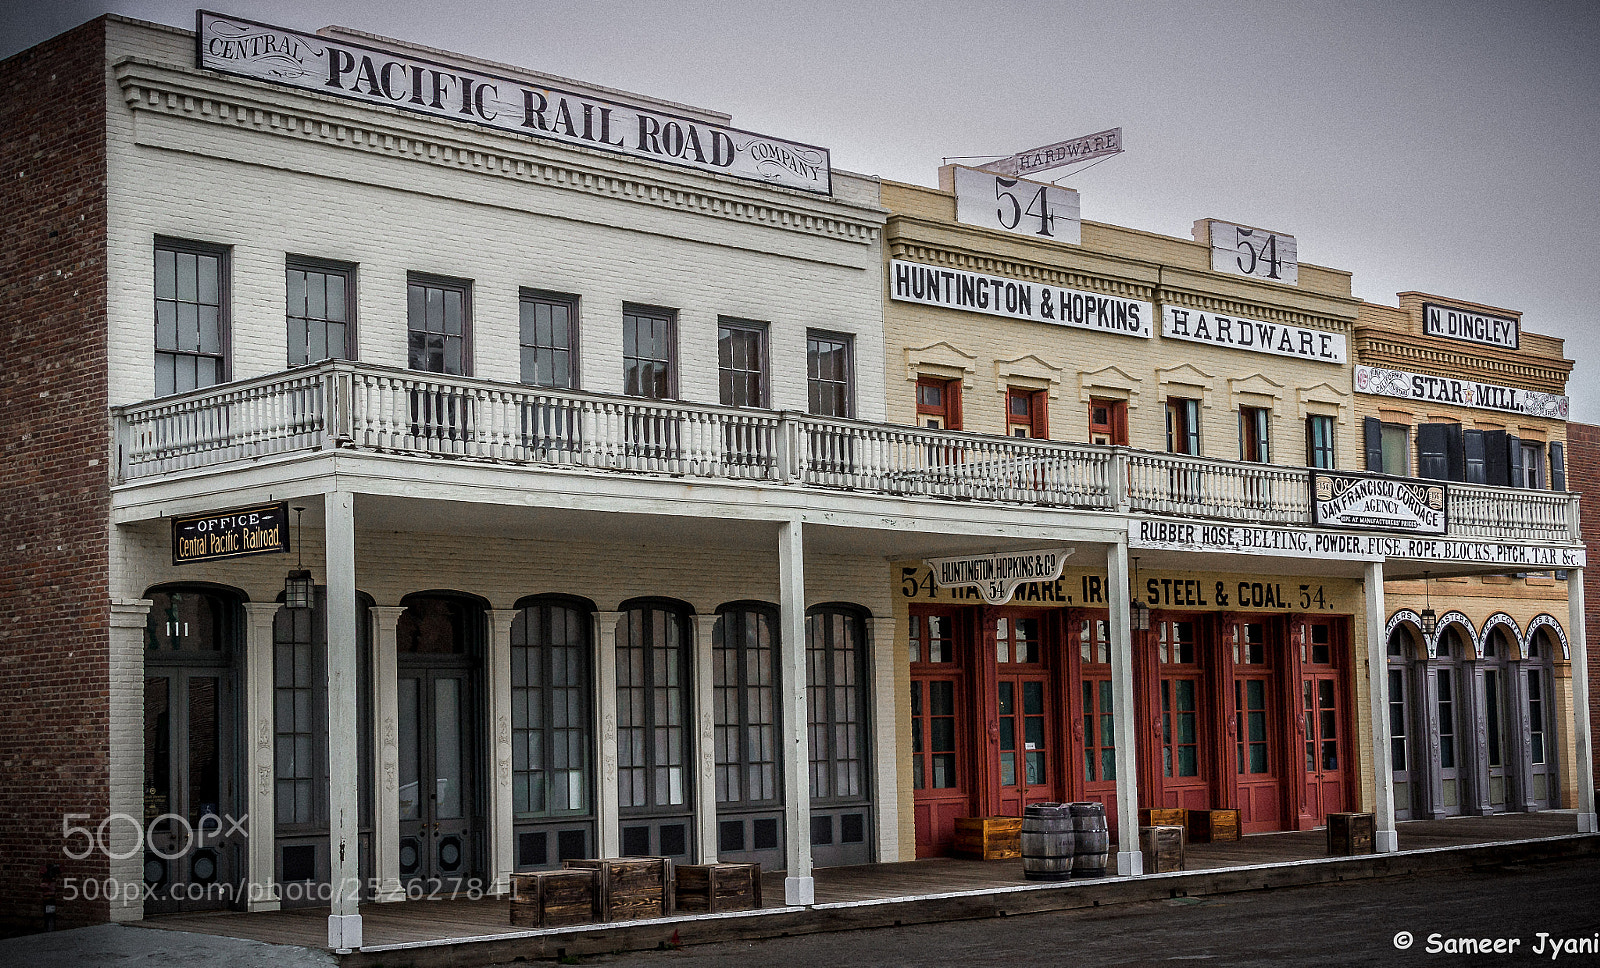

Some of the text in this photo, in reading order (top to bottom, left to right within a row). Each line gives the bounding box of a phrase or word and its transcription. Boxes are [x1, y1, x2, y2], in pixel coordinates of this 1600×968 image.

[208, 34, 305, 65] CENTRAL
[324, 46, 736, 168] PACIFIC RAIL ROAD
[750, 143, 820, 181] COMPANY
[1018, 133, 1119, 171] HARDWARE
[995, 176, 1055, 237] 54
[1236, 226, 1282, 280] 54
[895, 263, 1031, 316] HUNTINGTON
[1040, 288, 1056, 320] &
[1171, 309, 1338, 360] HARDWARE.
[1430, 308, 1513, 345] N. DINGLEY.
[1412, 375, 1463, 404] STAR
[1475, 384, 1525, 412] MILL.
[1321, 480, 1439, 527] SAN FRANCISCO CORDAGE
[1363, 499, 1400, 514] AGENCY
[197, 513, 260, 532] OFFICE
[179, 534, 207, 557] Central
[210, 529, 239, 554] Pacific
[1140, 521, 1195, 544] RUBBER
[1242, 528, 1312, 554] BELTING,
[1315, 534, 1365, 556] POWDER,
[1367, 537, 1405, 558] FUSE,
[1409, 540, 1441, 560] ROPE,
[1443, 542, 1495, 562] BLOCKS,
[1497, 545, 1530, 564] PITCH,
[1532, 546, 1557, 565] TAR
[996, 555, 1034, 580] HOPKINS
[1036, 554, 1044, 577] &
[902, 567, 939, 598] 54
[1146, 578, 1207, 606] STEEL
[1215, 581, 1229, 607] &
[1238, 581, 1292, 609] COAL.
[1299, 584, 1334, 610] 54.
[989, 580, 1004, 599] 54
[166, 621, 189, 637] 111
[1545, 615, 1550, 623] &
